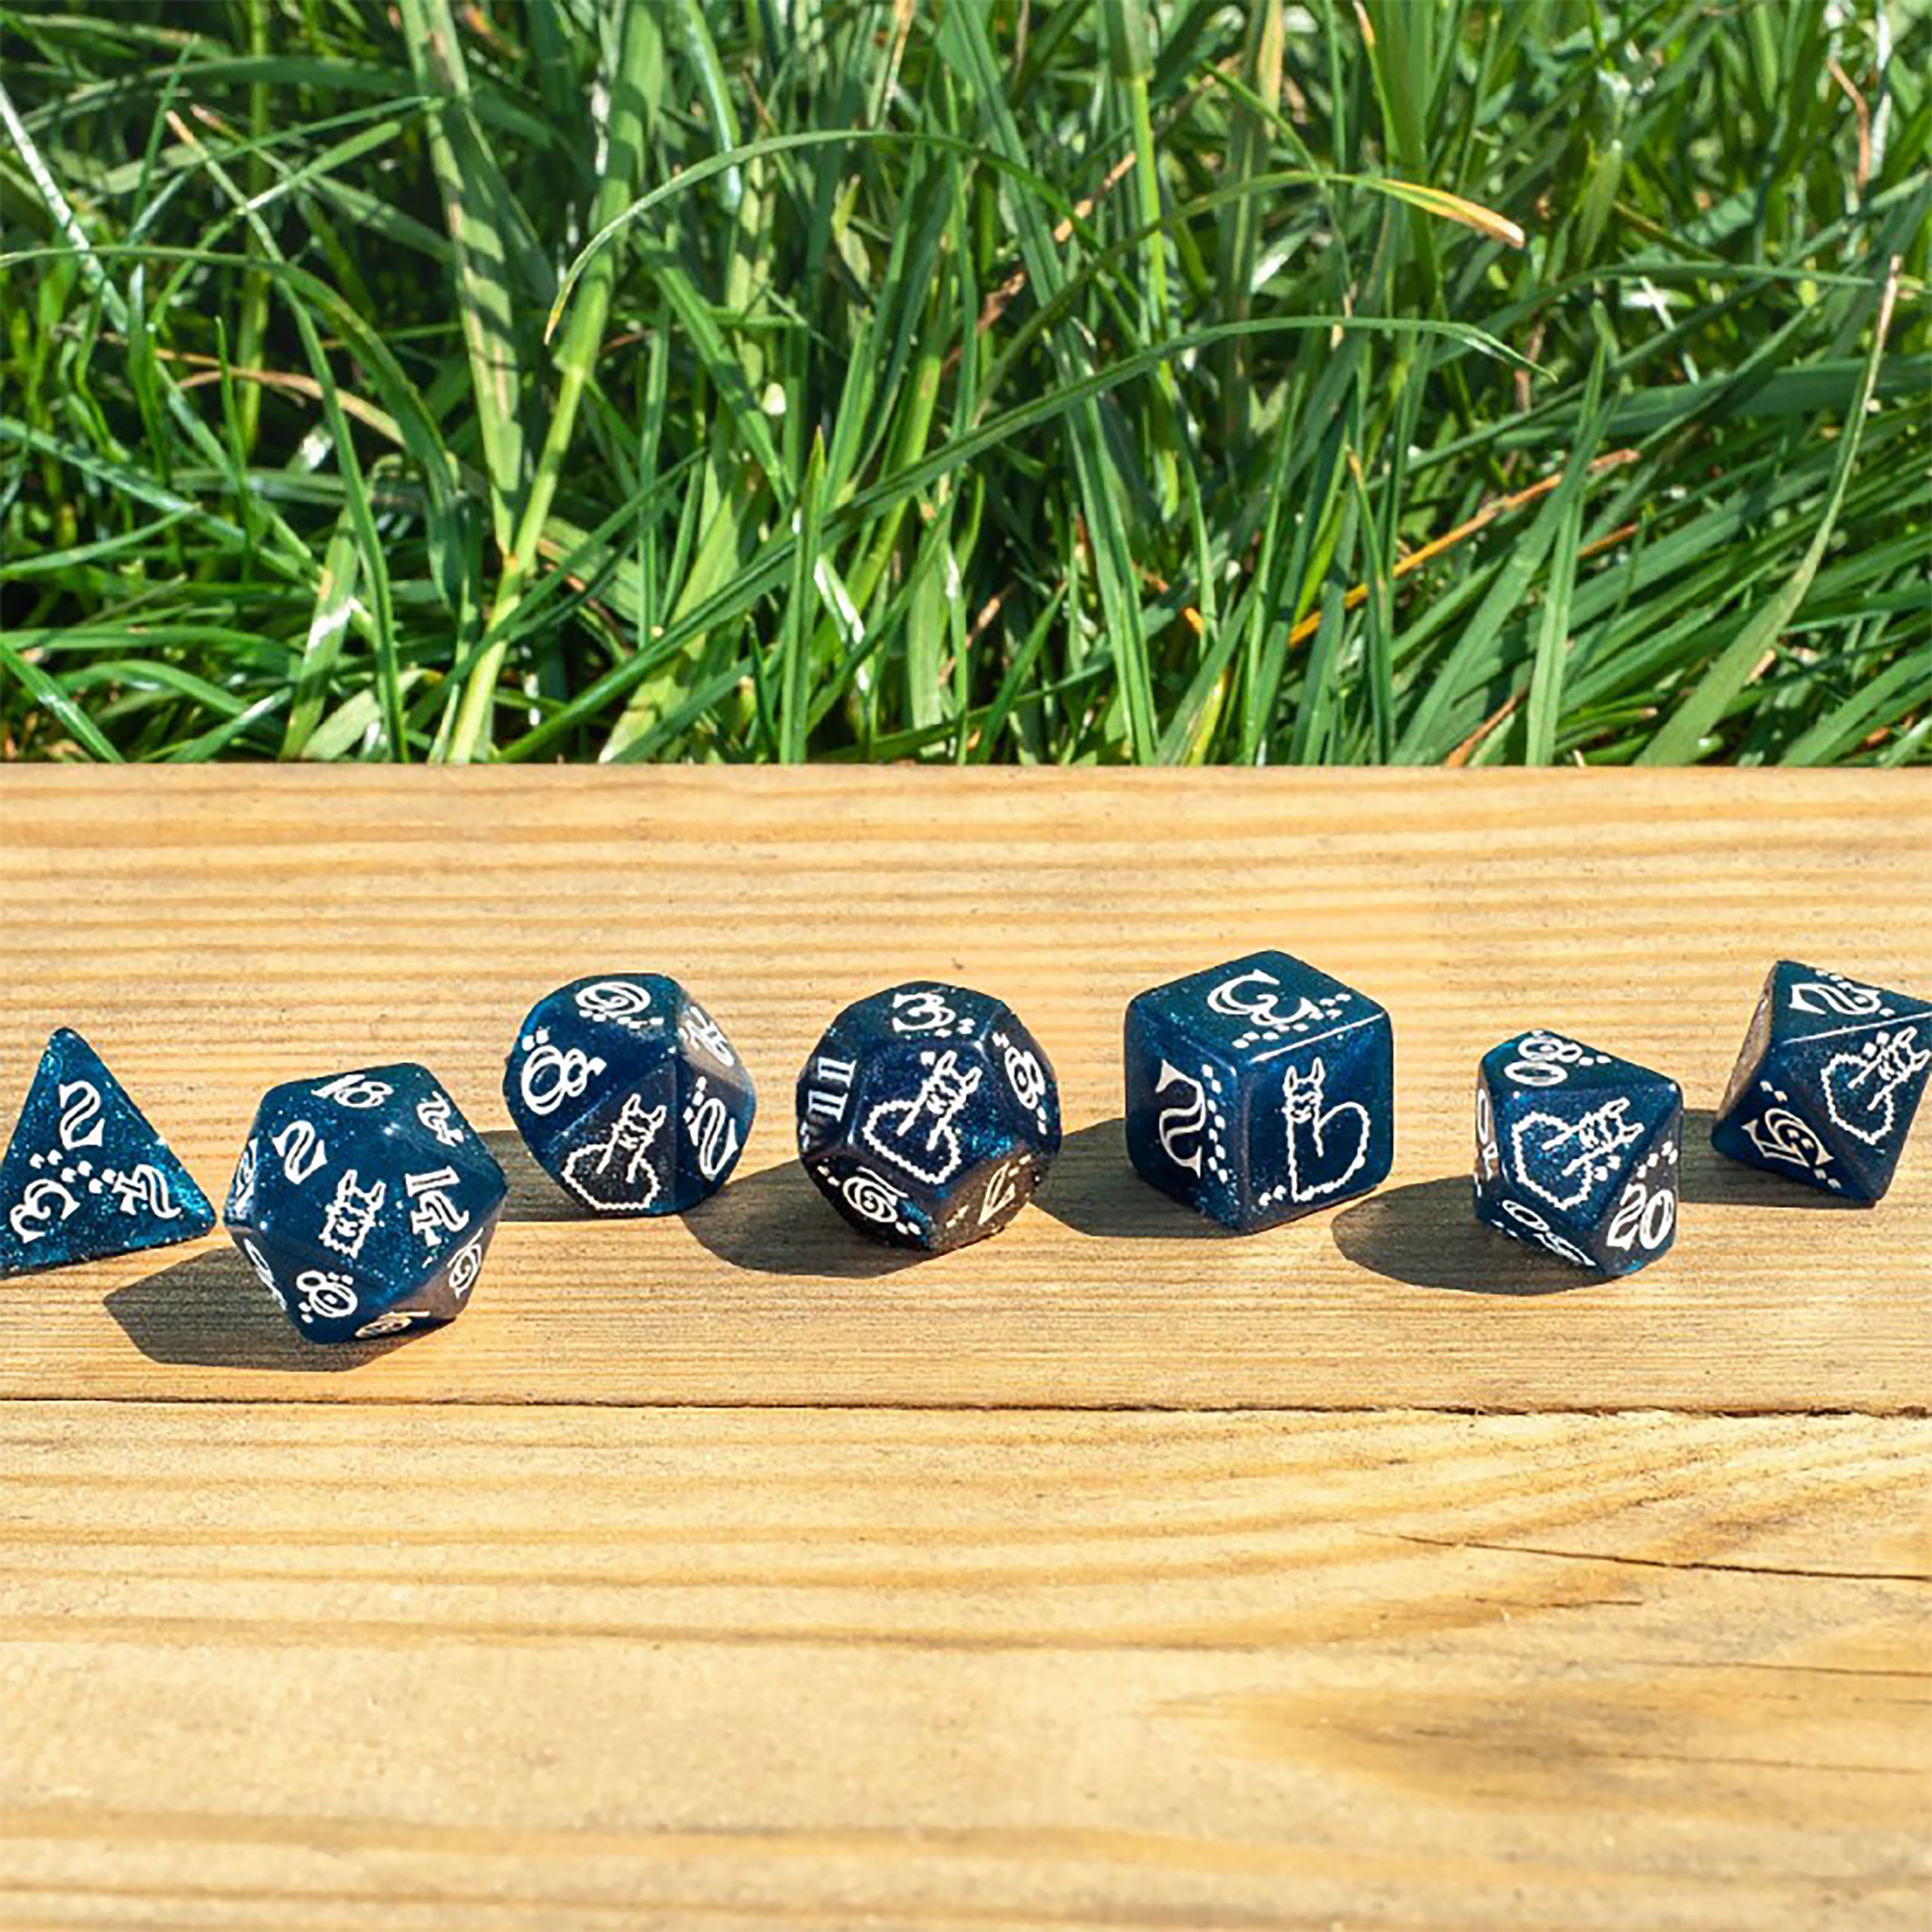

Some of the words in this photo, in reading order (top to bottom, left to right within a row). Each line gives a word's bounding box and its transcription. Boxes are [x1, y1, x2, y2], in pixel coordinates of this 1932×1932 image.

[893, 993, 956, 1033] 3
[1208, 969, 1319, 1026] 3
[311, 1074, 394, 1109] 18
[521, 1045, 588, 1115] 8
[1004, 1046, 1046, 1110] 8
[1504, 1036, 1583, 1087] 80
[59, 1080, 106, 1150] 2
[688, 1098, 739, 1182] 2
[1155, 1059, 1207, 1179] 2
[1741, 1108, 1835, 1168] 5
[272, 1120, 328, 1185] 2
[10, 1178, 80, 1243] 3
[112, 1164, 181, 1218] 4
[1606, 1183, 1675, 1251] 20
[296, 1269, 358, 1318] 8
